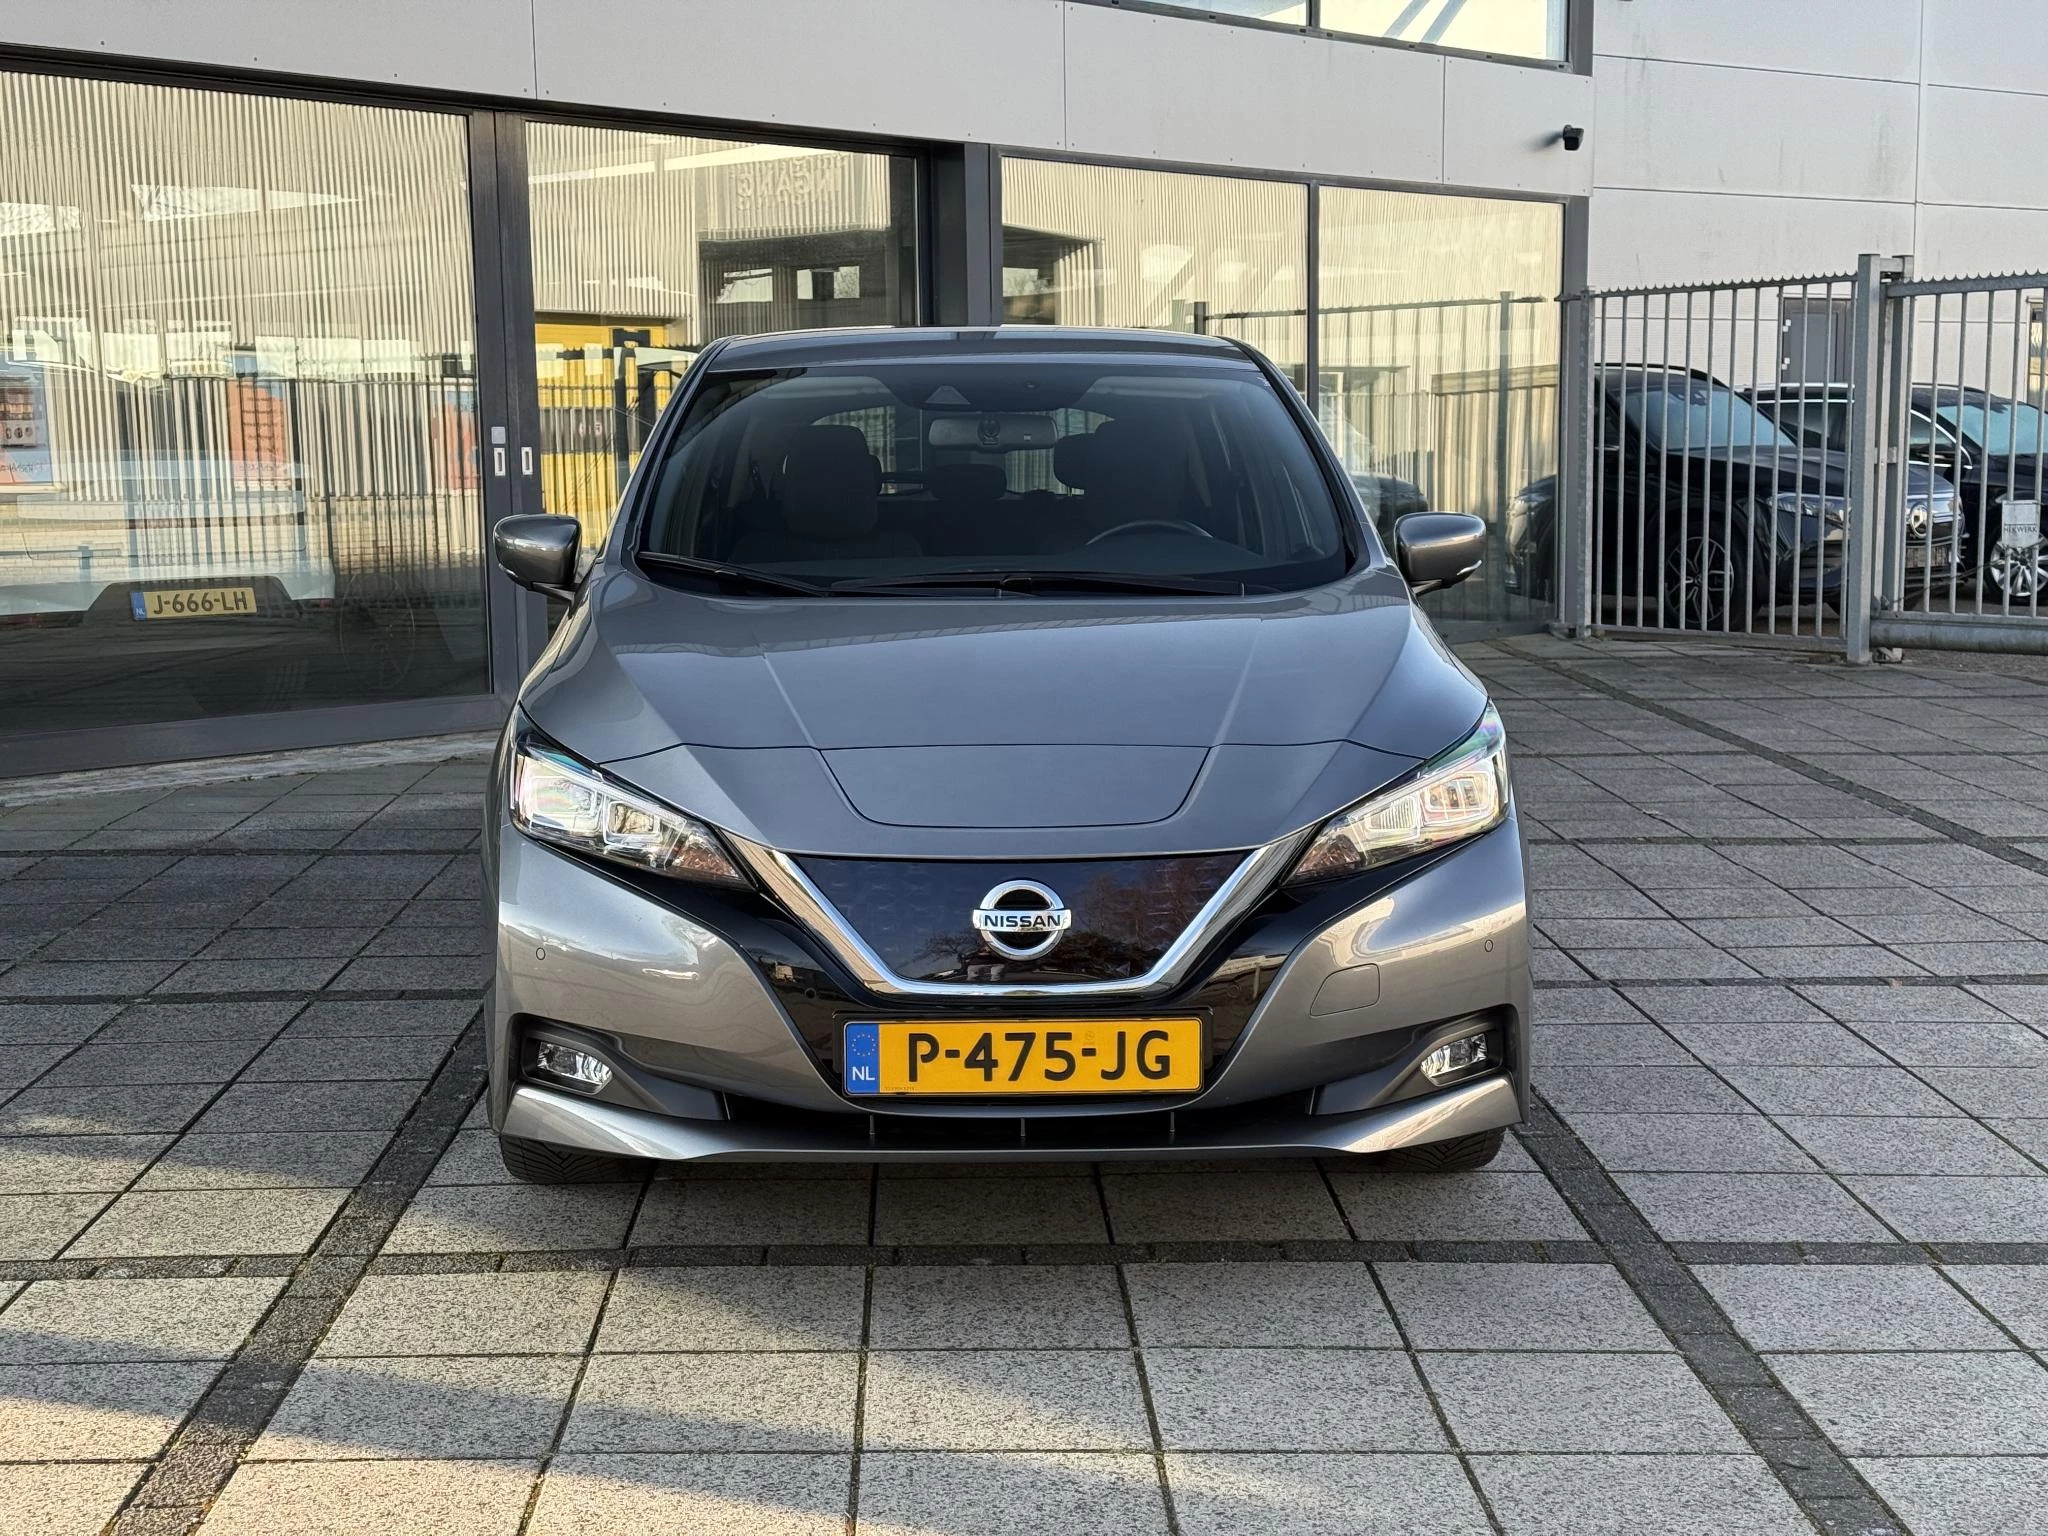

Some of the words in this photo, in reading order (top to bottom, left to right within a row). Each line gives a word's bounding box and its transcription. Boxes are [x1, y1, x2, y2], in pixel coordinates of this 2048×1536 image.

[153, 591, 248, 615] J-666-LH
[984, 914, 1061, 928] NISSAN
[852, 1066, 876, 1081] NL
[908, 1030, 1171, 1083] P-475-JG
